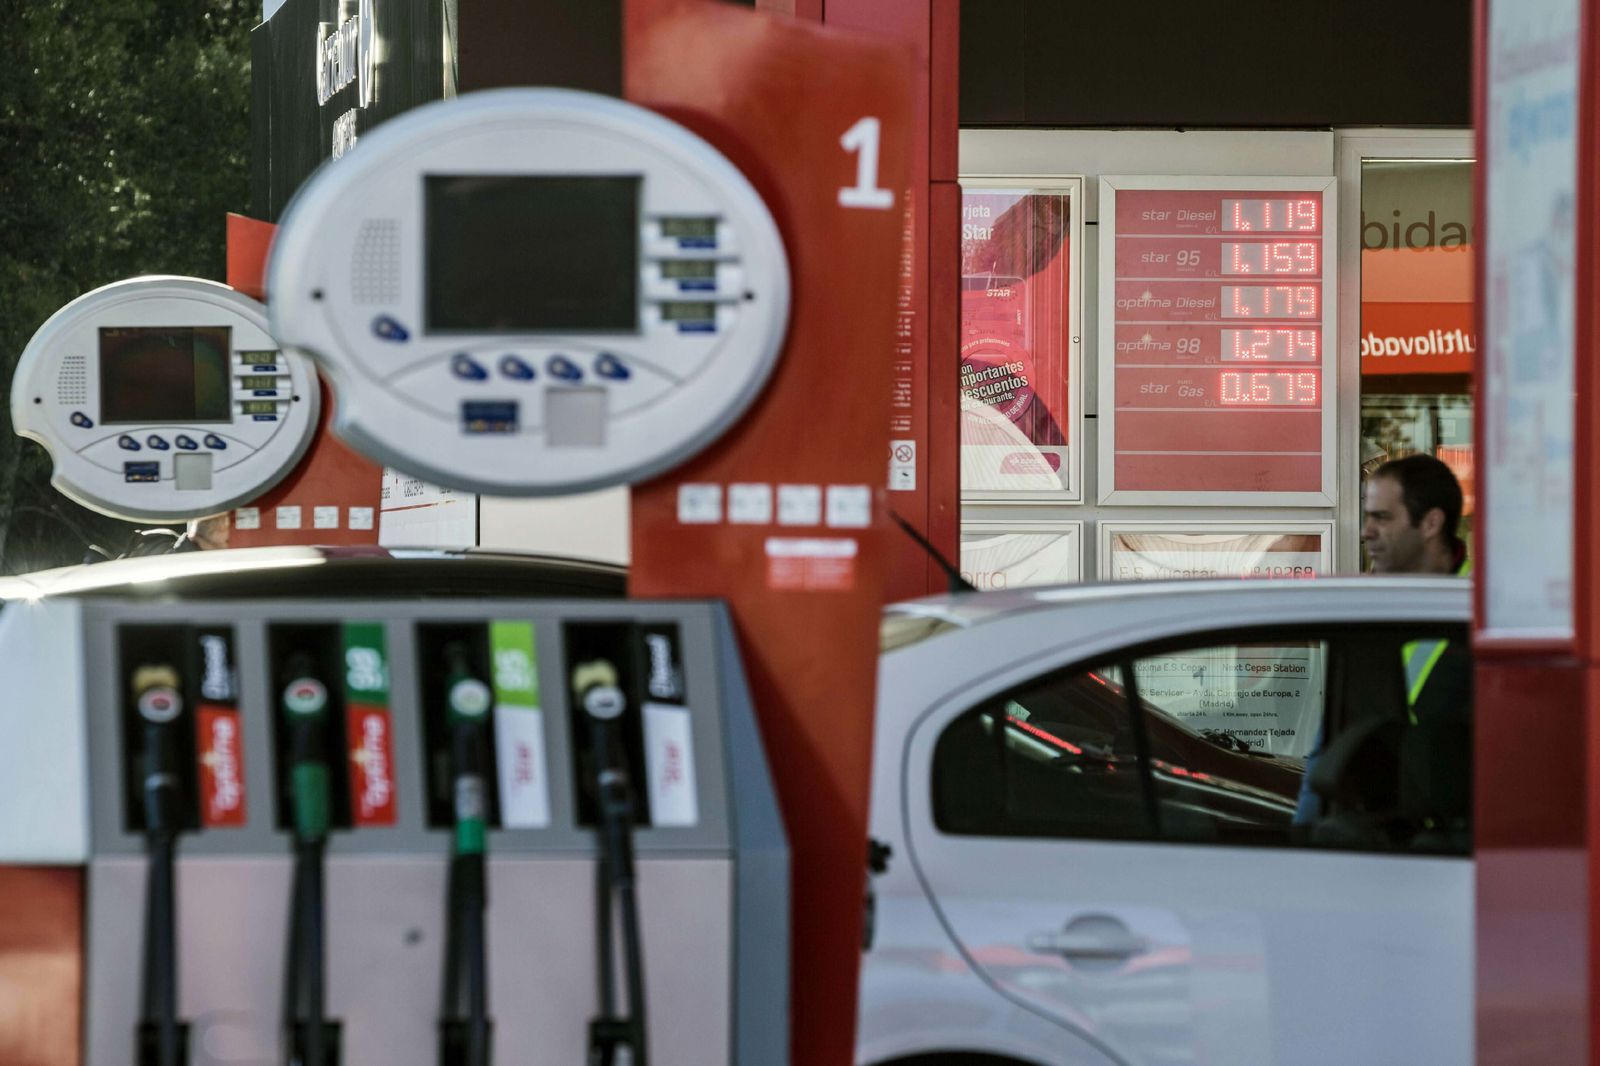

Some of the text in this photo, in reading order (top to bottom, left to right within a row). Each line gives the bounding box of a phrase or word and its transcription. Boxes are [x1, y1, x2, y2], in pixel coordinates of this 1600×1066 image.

[838, 117, 896, 209] 1
[1142, 200, 1316, 230] star Diesel 1.119
[962, 224, 994, 241] Star
[1362, 210, 1475, 252] bida
[1141, 243, 1316, 272] star 95 1.159
[986, 289, 1011, 297] STAR
[1117, 286, 1316, 316] optima Diesel 1.179
[1117, 329, 1316, 359] optima 98 1.274
[961, 376, 1028, 399] escuentos
[1140, 373, 1316, 401] star Gas 0.679
[1222, 663, 1306, 674] Next Cepsa Station
[1251, 689, 1262, 698] de
[1262, 689, 1294, 700] Europa,
[1294, 690, 1301, 698] 2
[1269, 728, 1296, 739] Tejada
